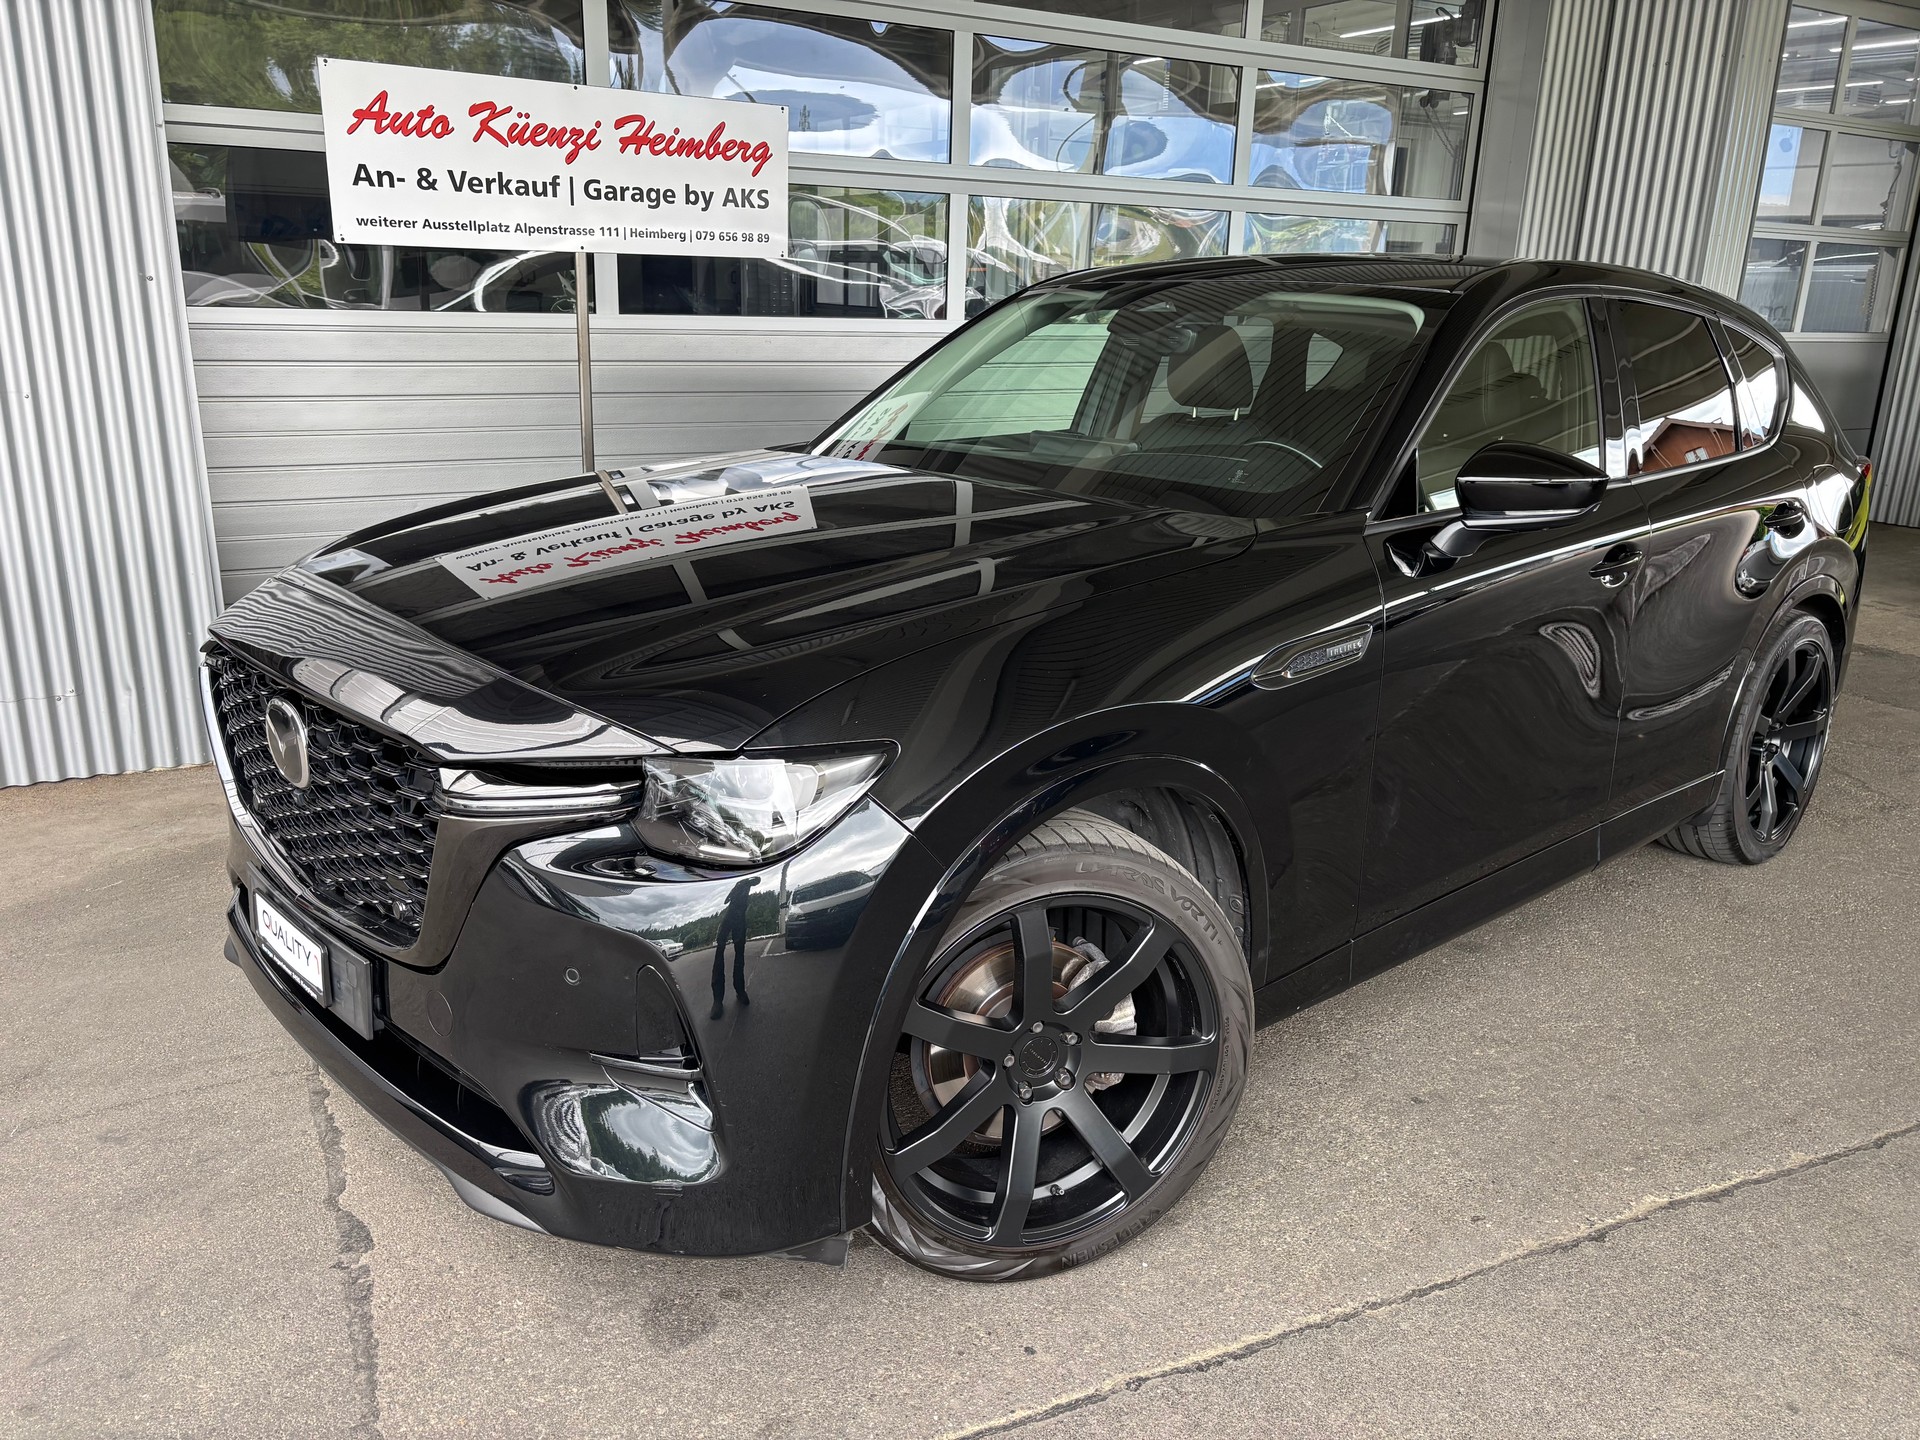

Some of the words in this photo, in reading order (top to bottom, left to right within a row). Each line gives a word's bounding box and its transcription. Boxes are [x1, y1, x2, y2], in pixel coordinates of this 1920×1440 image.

[347, 90, 454, 139] Auto
[468, 101, 601, 165] Küenzi
[614, 114, 772, 177] Heimberg
[352, 164, 405, 188] An-
[417, 168, 438, 191] &
[447, 170, 560, 198] Verkauf
[584, 179, 676, 207] Garage
[685, 184, 714, 211] by
[722, 188, 769, 209] AKS
[356, 216, 418, 228] weiterer
[422, 219, 510, 234] Ausstellplatz
[514, 223, 595, 236] Alpenstrasse
[600, 227, 619, 237] 111
[630, 228, 686, 242] Heimberg
[696, 231, 715, 241] 079
[719, 232, 738, 241] 656
[742, 233, 754, 242] 98
[757, 233, 769, 243] 89
